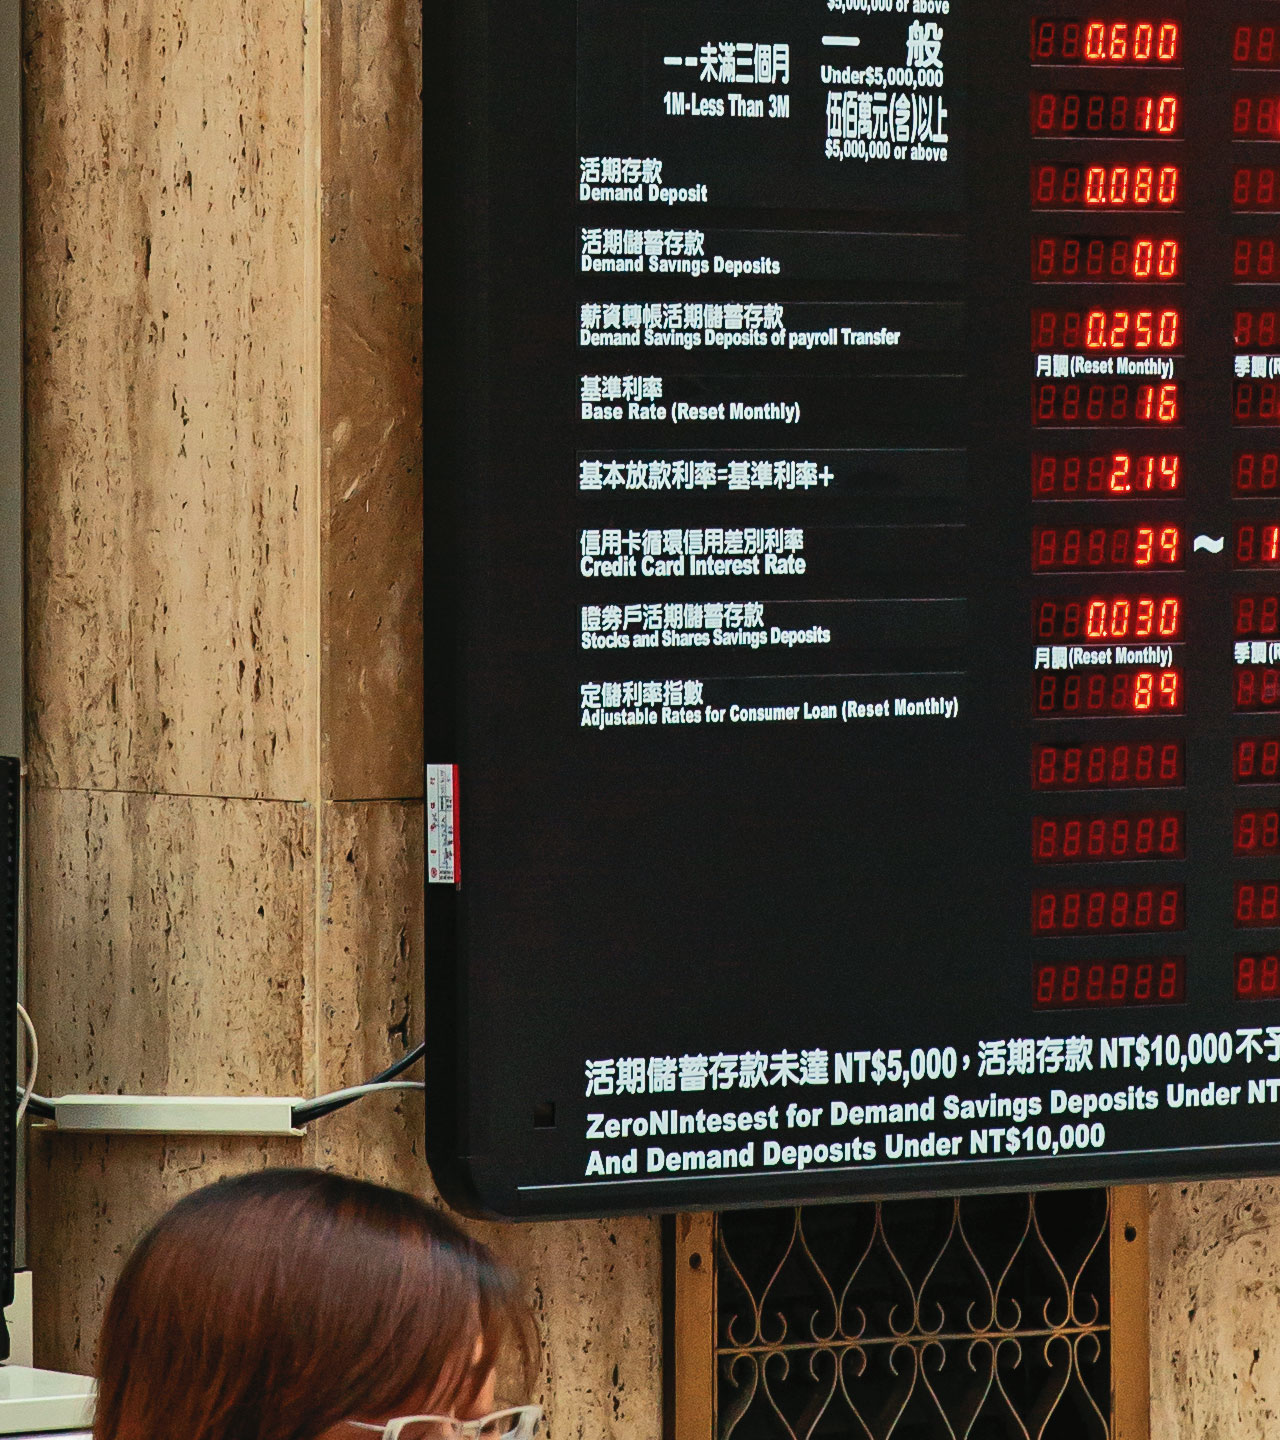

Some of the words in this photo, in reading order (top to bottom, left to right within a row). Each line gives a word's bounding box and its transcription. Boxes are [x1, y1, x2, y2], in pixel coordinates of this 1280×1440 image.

[1086, 24, 1176, 59] 0.600
[664, 91, 724, 116] 1M-Less
[728, 94, 763, 117] Than
[769, 94, 789, 118] 3M
[580, 157, 662, 187] 活期存款
[1087, 168, 1176, 202] 0.080
[580, 183, 642, 201] Demand
[649, 184, 707, 205] Deposit
[581, 228, 704, 260] 活期儲蓄存款
[582, 255, 643, 272] Demand
[646, 252, 709, 277] Savings
[714, 256, 780, 277] Deposits
[581, 303, 786, 332] 薪資轉帳活期儲蓄存款
[1087, 312, 1177, 347] 0.250
[581, 326, 640, 346] Demand
[644, 326, 701, 350] Savings
[705, 326, 767, 349] Deposits
[771, 325, 786, 345] of
[789, 328, 837, 349] payroll
[841, 328, 900, 345] Transfer
[581, 375, 662, 401] 基準利率
[582, 403, 623, 419] Base
[629, 403, 666, 419] Rate
[672, 402, 725, 424] (Reset
[730, 402, 800, 423] Monthly)
[579, 460, 834, 490] 基本放款利率=基準利率+
[1111, 456, 1177, 491] 2.14
[580, 528, 803, 559] 信用卡循環信用差別利率
[1136, 529, 1177, 564] 39
[581, 553, 636, 577] Credit
[642, 552, 684, 576] Card
[689, 552, 760, 575] Interest
[765, 552, 806, 574] Rate
[1088, 600, 1177, 637] 0.030
[582, 628, 630, 649] Stocks
[633, 630, 659, 647] and
[662, 630, 710, 647] Shares
[710, 626, 767, 649] Savings
[771, 626, 830, 647] Deposits
[581, 680, 703, 711] 定儲利率指數
[581, 707, 657, 730] Adjustable
[662, 707, 701, 724] Rates
[705, 706, 726, 722] for
[730, 705, 800, 722] Consumer
[804, 702, 837, 719] Loan
[842, 700, 889, 722] (Reset
[895, 696, 958, 718] Monthly)
[584, 1047, 829, 1098] 活期儲蓄存款未達
[786, 1103, 823, 1128] for
[831, 1097, 934, 1125] Demand
[943, 1093, 1042, 1122] Savings
[1051, 1086, 1158, 1118] Deposits
[1167, 1082, 1241, 1107] Under
[585, 1149, 637, 1175] And
[647, 1142, 758, 1177] Demand
[760, 1137, 880, 1174] Deposits
[886, 1132, 962, 1158] Under
[971, 1122, 1106, 1160] NT$10,000
